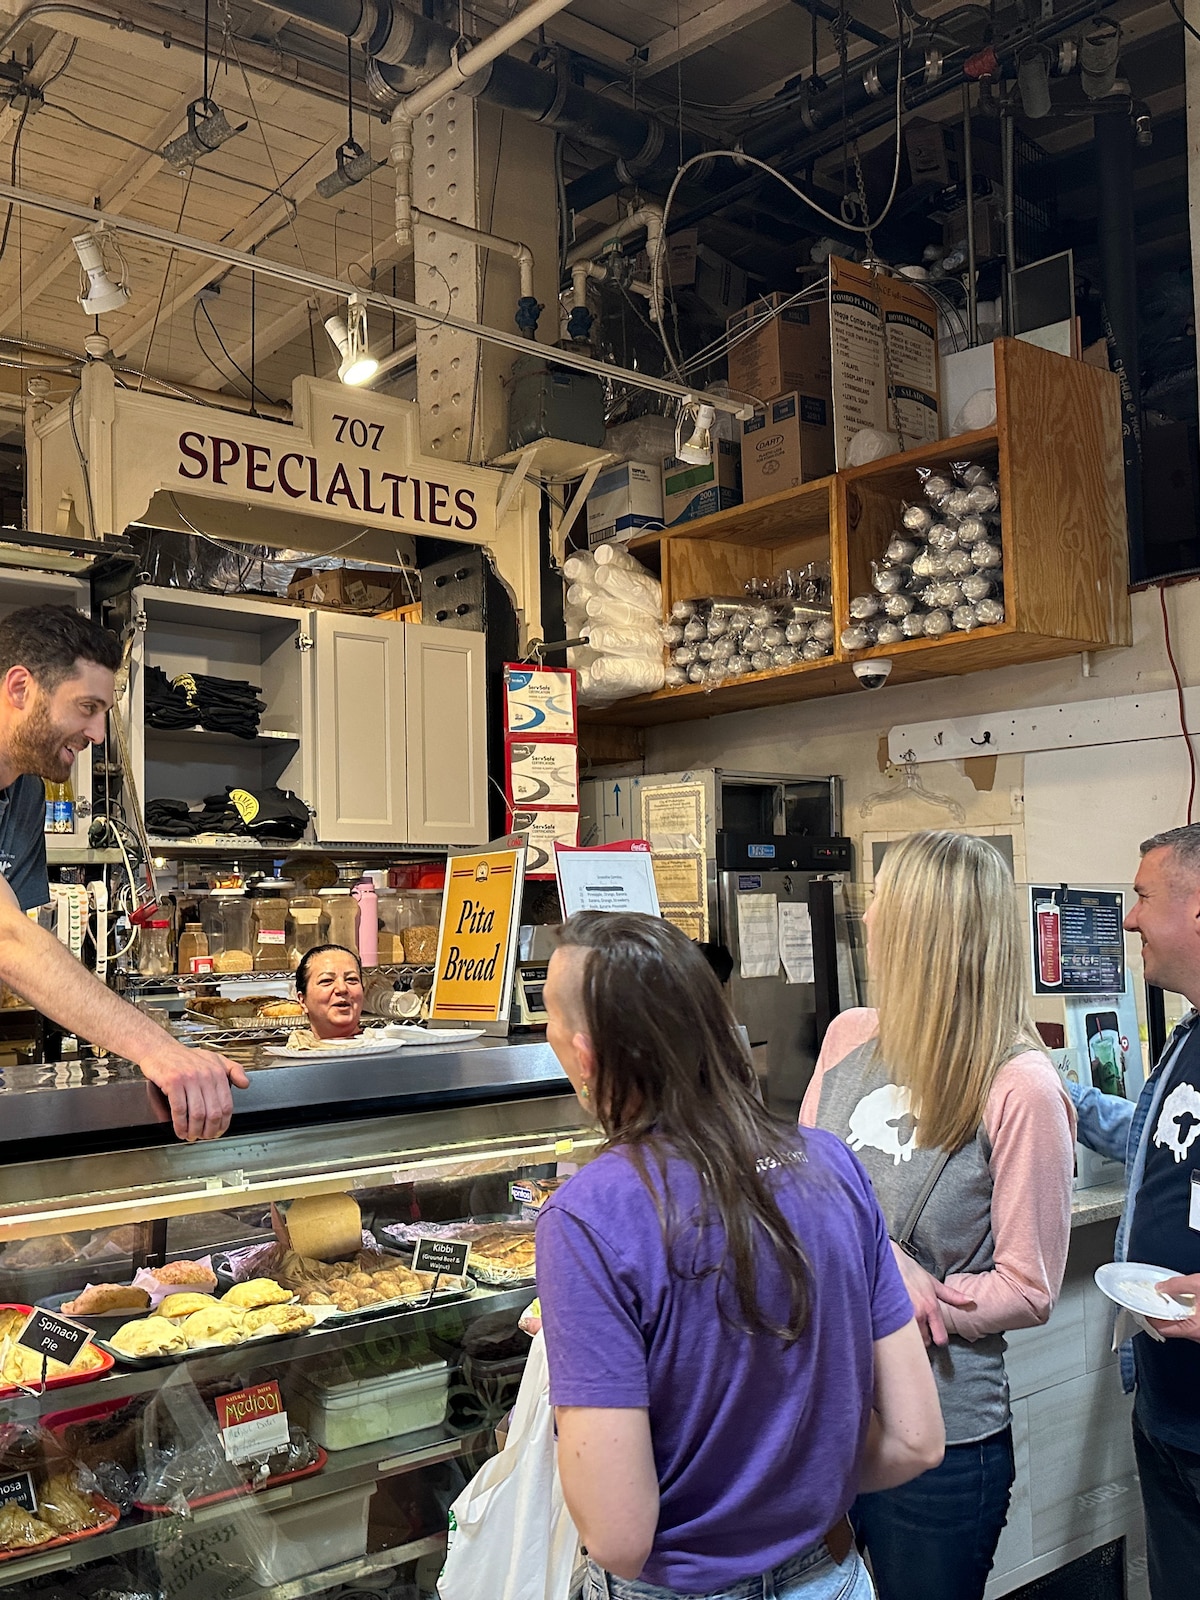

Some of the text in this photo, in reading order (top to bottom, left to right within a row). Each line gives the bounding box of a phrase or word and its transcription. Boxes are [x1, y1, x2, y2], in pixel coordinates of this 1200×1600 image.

[900, 388, 925, 401] SALADS
[331, 413, 386, 452] 707
[759, 436, 781, 449] DART
[178, 429, 479, 531] SPECIALTIES
[455, 899, 496, 934] Pita
[441, 942, 501, 982] Bread
[432, 1243, 455, 1254] Kibbi
[422, 1253, 443, 1262] (Ground
[429, 1261, 451, 1271] Walnut)
[38, 1316, 79, 1343] Spinach
[40, 1336, 59, 1352] Pie
[225, 1386, 272, 1403] NATURAL DATES
[225, 1391, 281, 1427] Medjool
